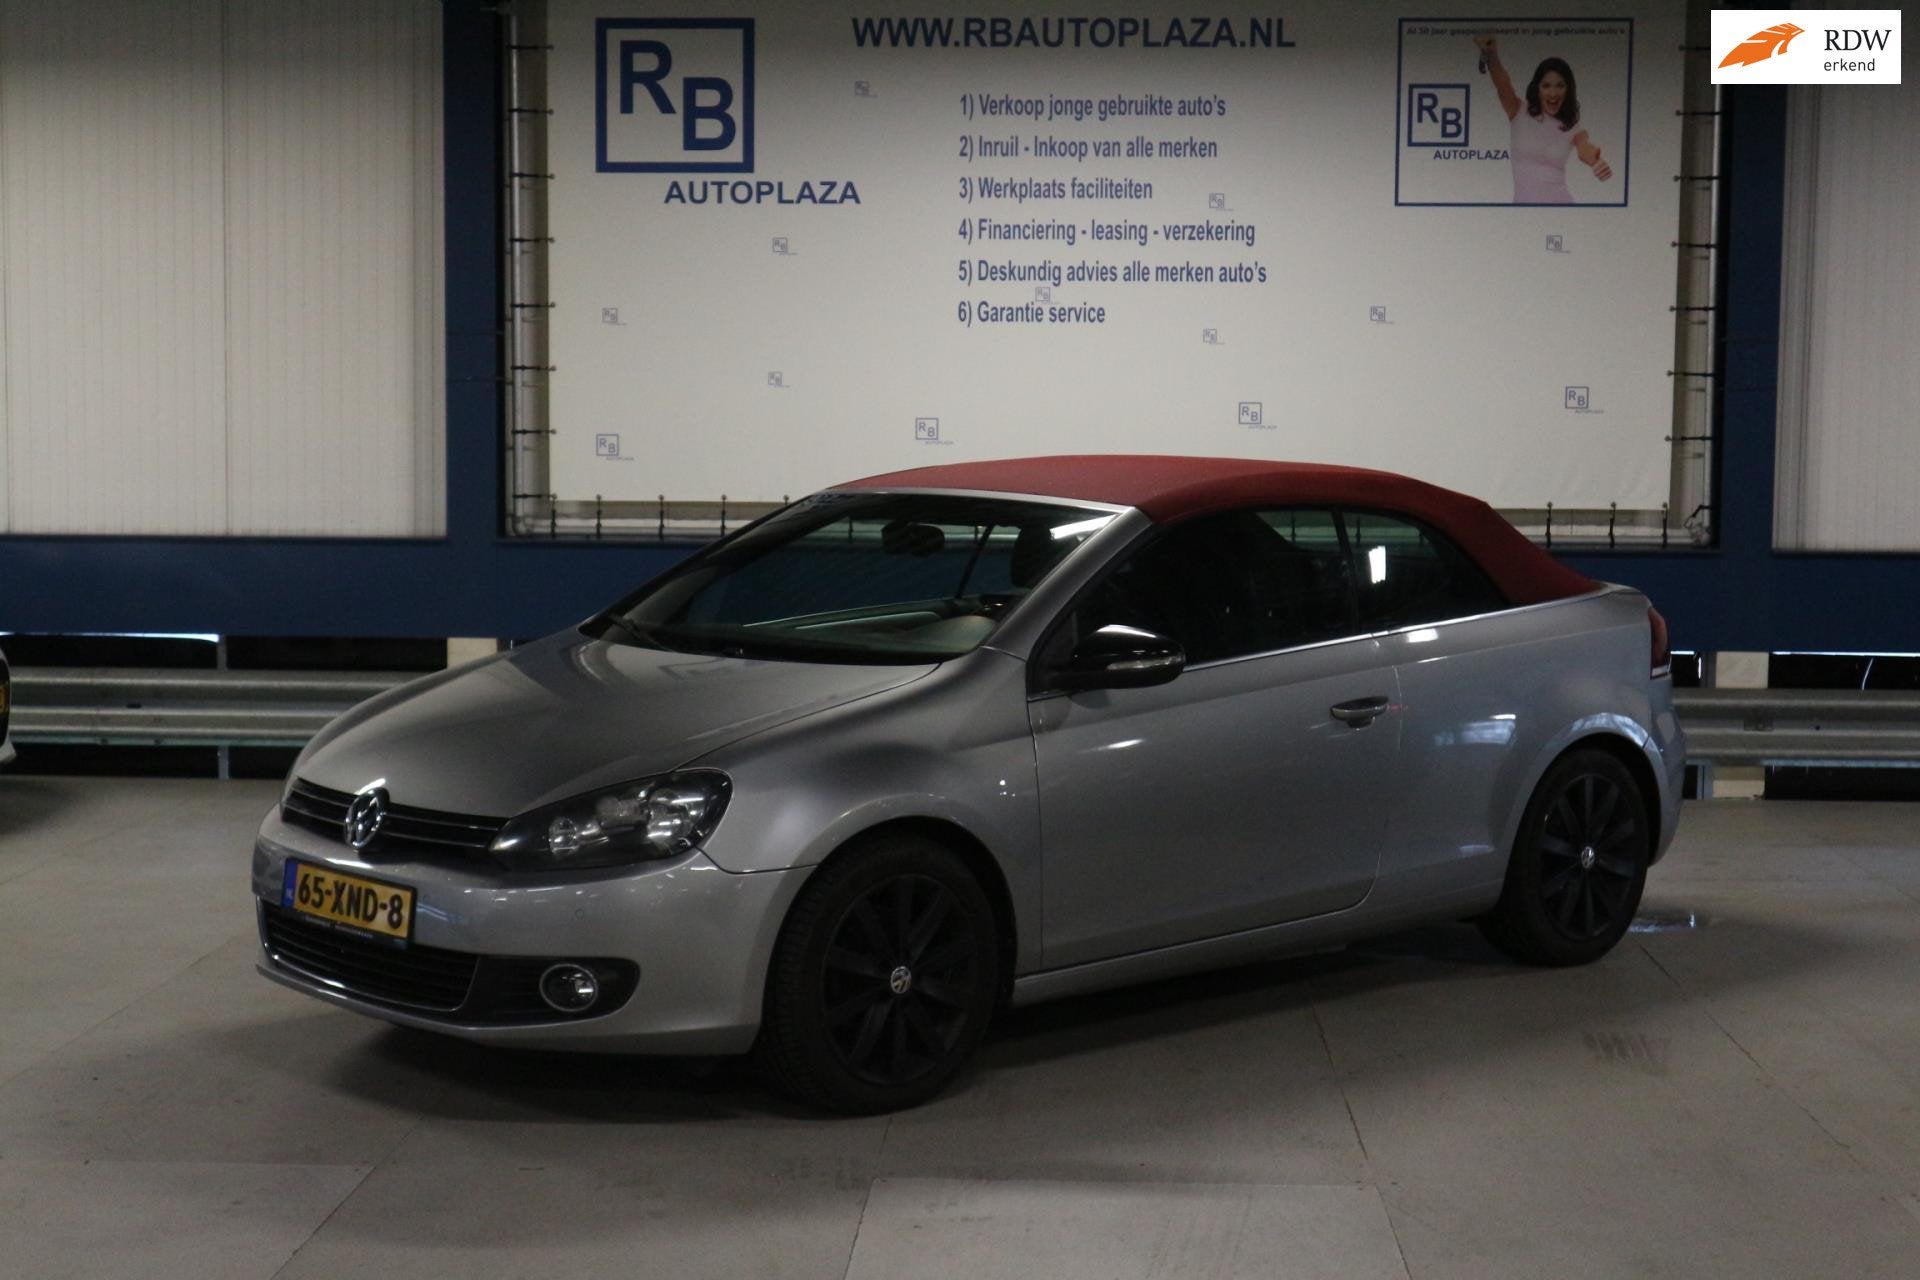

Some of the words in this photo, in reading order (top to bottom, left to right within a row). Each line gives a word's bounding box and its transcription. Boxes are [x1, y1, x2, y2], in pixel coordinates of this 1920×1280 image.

[852, 17, 1296, 48] WWW.RBAUTOPLAZA.NL
[960, 93, 974, 120] 1)
[979, 94, 1044, 120] Verkoop
[1048, 94, 1093, 121] jonge
[1098, 94, 1173, 121] gebruikte
[1178, 94, 1226, 116] auto's
[959, 135, 974, 162] 2)
[979, 135, 1019, 157] Inruil
[1034, 136, 1088, 162] Inkoop
[1093, 141, 1121, 157] van
[1126, 136, 1154, 157] alle
[1158, 136, 1217, 157] merken
[1433, 150, 1510, 160] AUTOPLAZA
[664, 181, 861, 205] AUTOPLAZA
[959, 177, 974, 204] 3)
[979, 177, 1066, 203] Werkplaats
[1070, 177, 1153, 199] faciliteiten
[958, 218, 973, 245] 4)
[978, 218, 1076, 246] Financiering
[1091, 219, 1148, 246] leasing
[1163, 220, 1255, 247] verzekering
[958, 260, 972, 287] 5)
[978, 260, 1062, 287] Deskundig
[1066, 260, 1118, 281] advies
[1122, 261, 1150, 282] alle
[1155, 261, 1214, 282] merken
[1219, 261, 1267, 283] auto's
[958, 301, 972, 328] 6)
[977, 301, 1044, 323] Garantie
[1048, 302, 1106, 323] service
[298, 872, 404, 930] 65-XND-8
